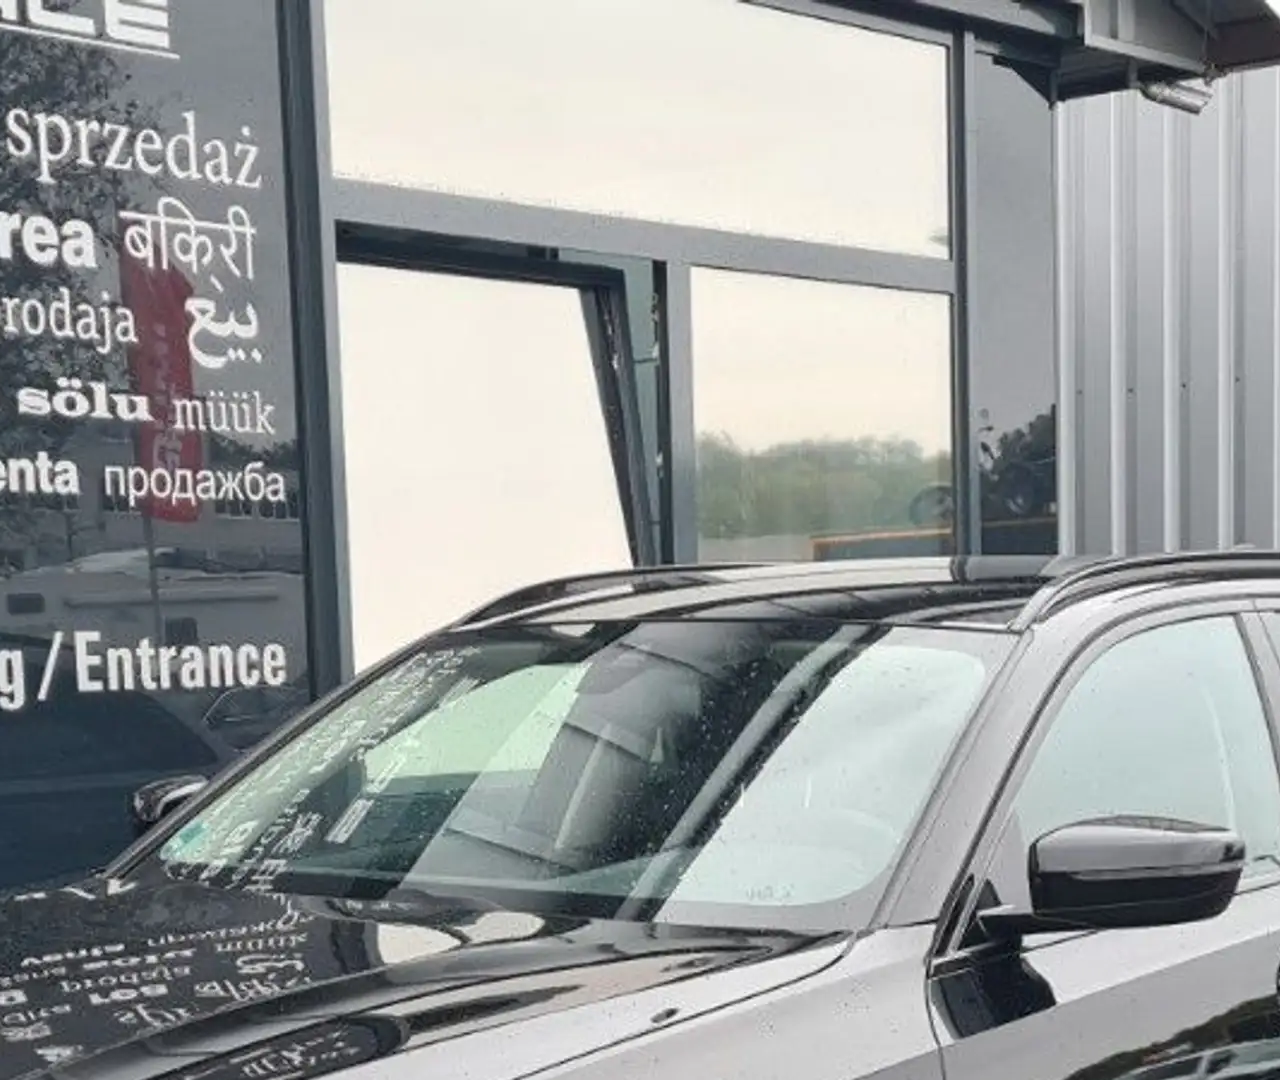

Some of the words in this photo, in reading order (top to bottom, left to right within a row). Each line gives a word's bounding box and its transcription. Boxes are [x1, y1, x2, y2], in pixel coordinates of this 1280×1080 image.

[5, 108, 263, 190] sprzedaż
[16, 376, 156, 422] sölu
[171, 390, 277, 436] müük
[103, 461, 287, 508] продажба
